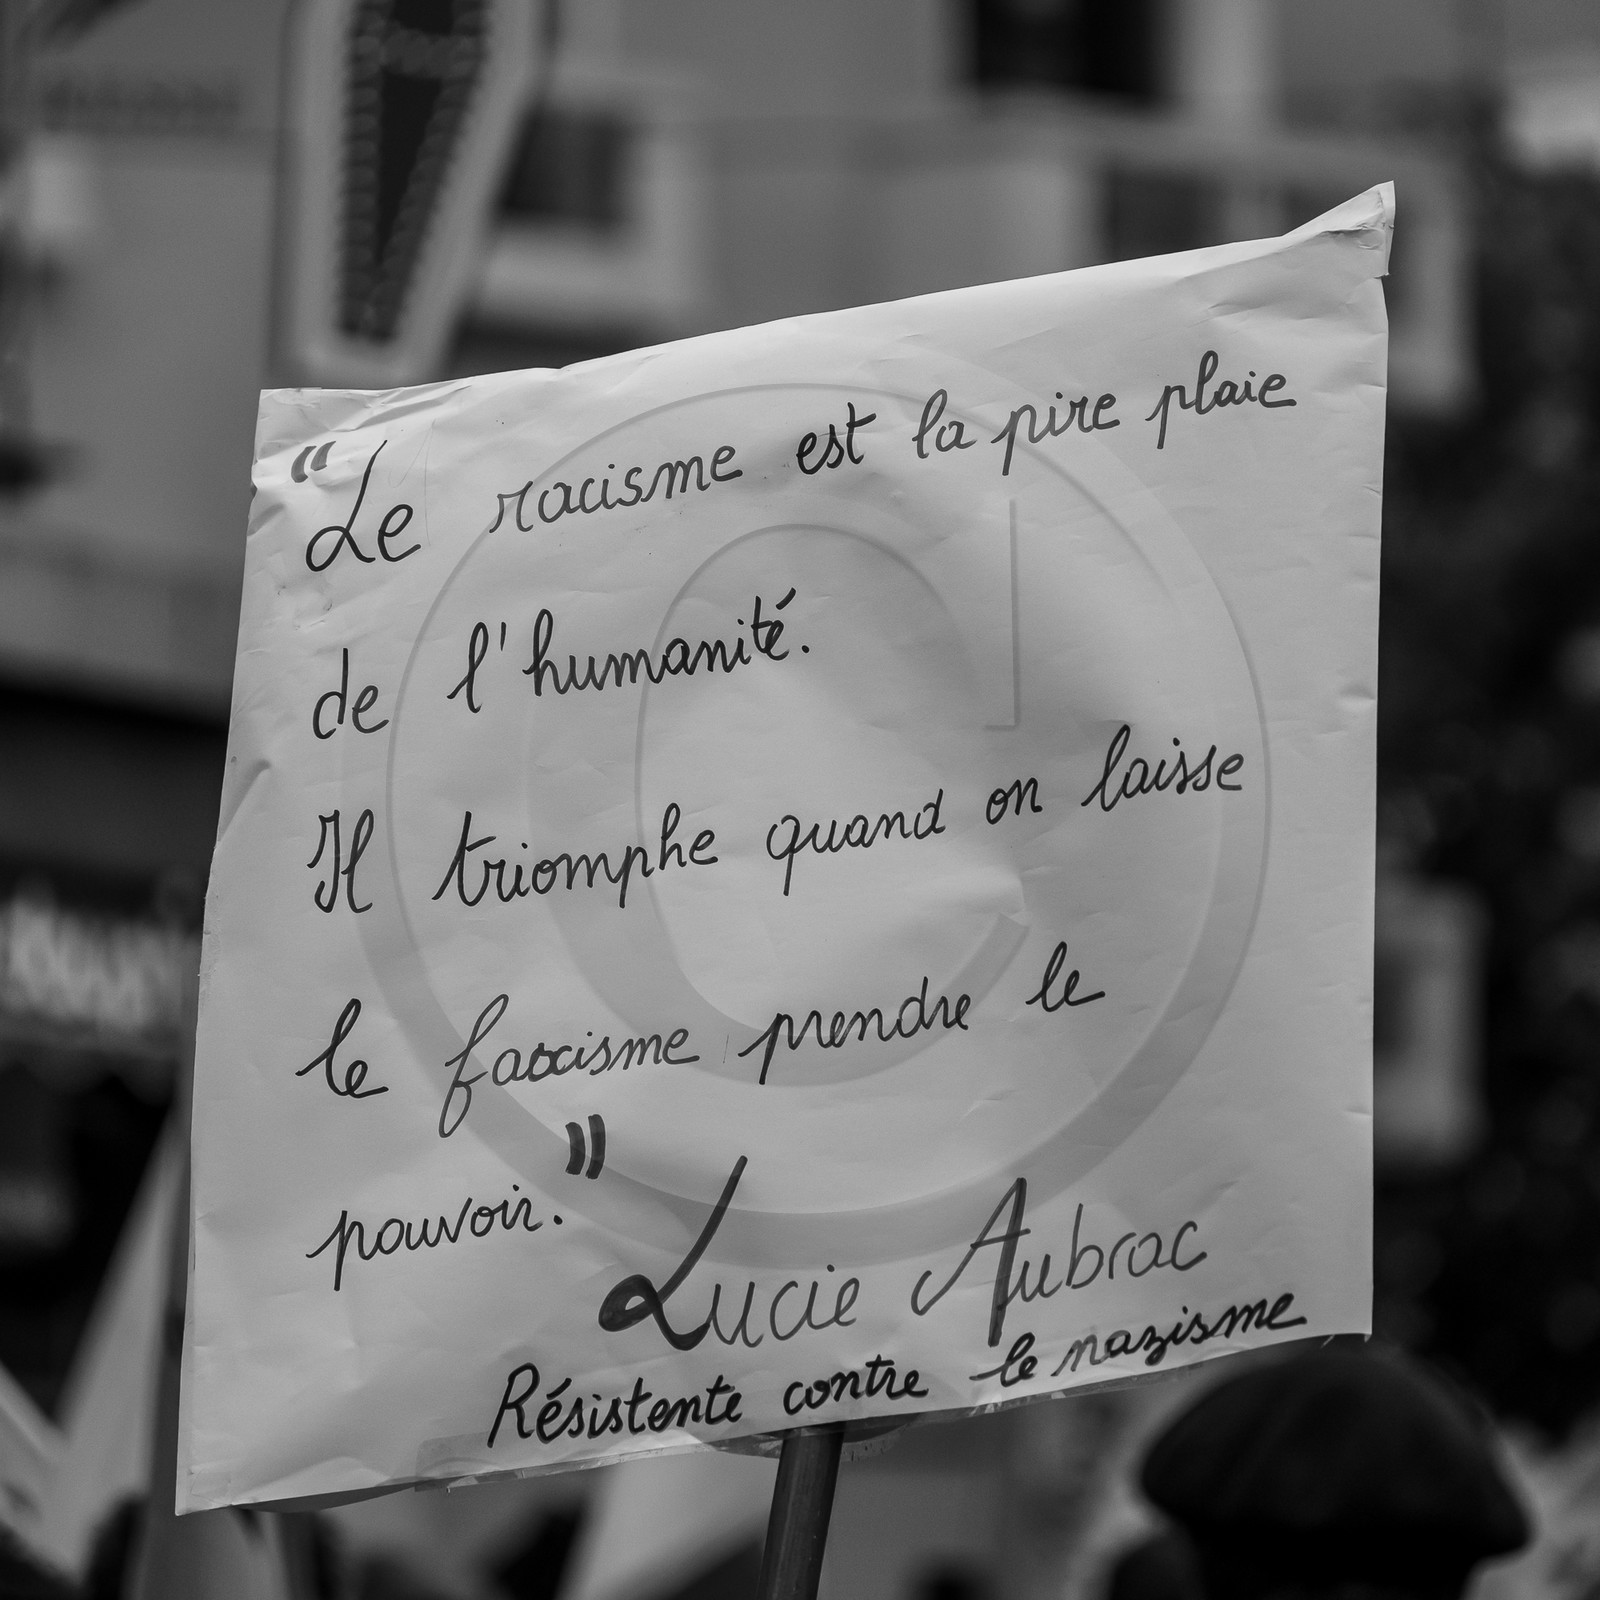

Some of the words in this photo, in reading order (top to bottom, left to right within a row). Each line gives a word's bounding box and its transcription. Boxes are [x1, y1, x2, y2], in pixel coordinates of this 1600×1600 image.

[487, 444, 745, 535] racisme
[794, 400, 878, 477] est
[910, 387, 979, 461] la
[989, 390, 1122, 478] pire
[1143, 348, 1299, 451] plaie
[311, 646, 391, 741] de
[305, 807, 376, 915] Il
[430, 801, 720, 910] triomphe
[764, 787, 948, 898] quand
[984, 776, 1045, 827] on
[1079, 722, 1246, 814] laisse
[293, 996, 391, 1100] le
[736, 974, 973, 1087] prendre
[1024, 939, 1107, 1014] le
[597, 1153, 861, 1353] Lucie
[909, 1175, 1209, 1349] Aubrac
[781, 1352, 931, 1417] contre
[967, 1330, 1040, 1389] le
[1049, 1291, 1309, 1378] nazisme
